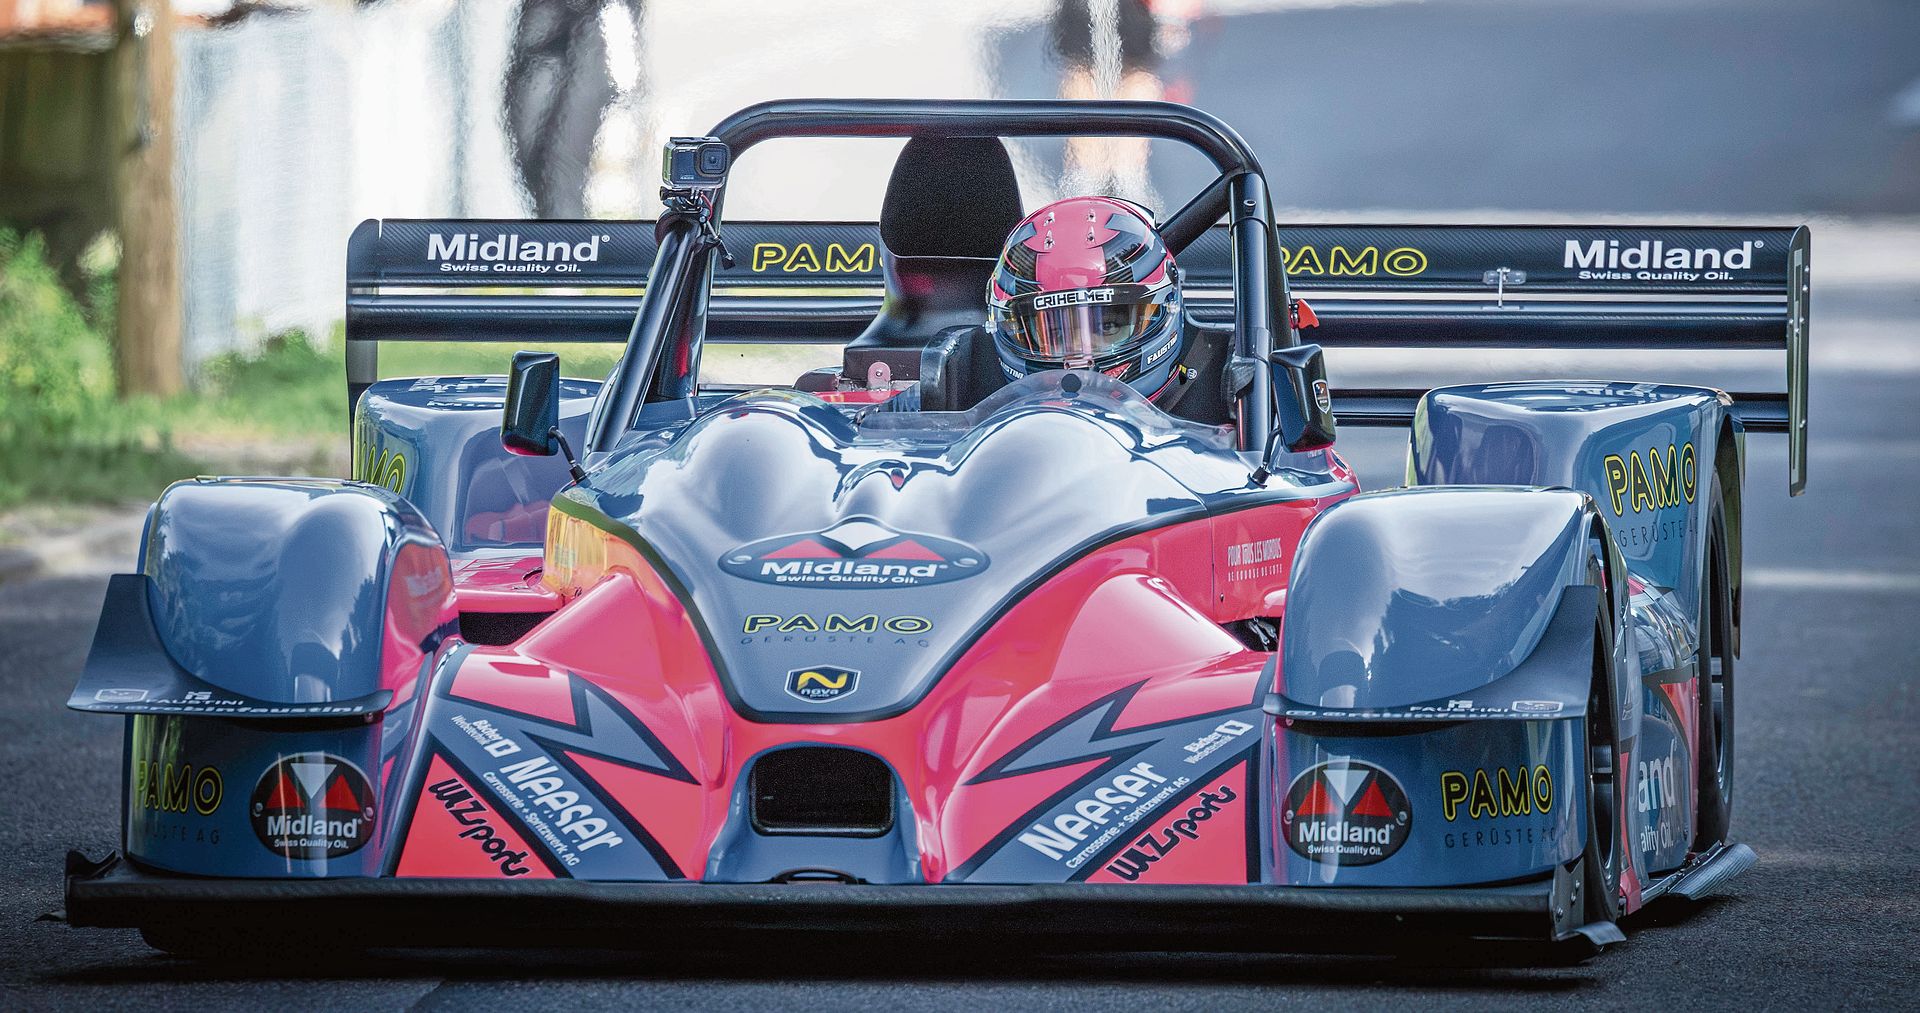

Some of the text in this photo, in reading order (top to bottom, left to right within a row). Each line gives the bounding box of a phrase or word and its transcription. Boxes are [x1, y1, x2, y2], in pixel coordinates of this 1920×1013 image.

[440, 263, 582, 273] Swiss Quality Oil.
[752, 243, 883, 272] PAM
[1578, 270, 1734, 281] Swiss Quality Oil.
[1604, 441, 1697, 517] PAMO
[776, 575, 825, 583] Swiss
[828, 575, 889, 584] Quality
[742, 613, 934, 635] PAMO
[1440, 764, 1553, 822] PAMO
[483, 771, 525, 809] Carrosserie
[562, 853, 581, 866] AG
[1065, 826, 1120, 868] Carrosserie
[1172, 776, 1191, 789] AG
[300, 838, 333, 849] Quality
[1308, 844, 1334, 854] Swiss
[1336, 844, 1369, 856] Quality
